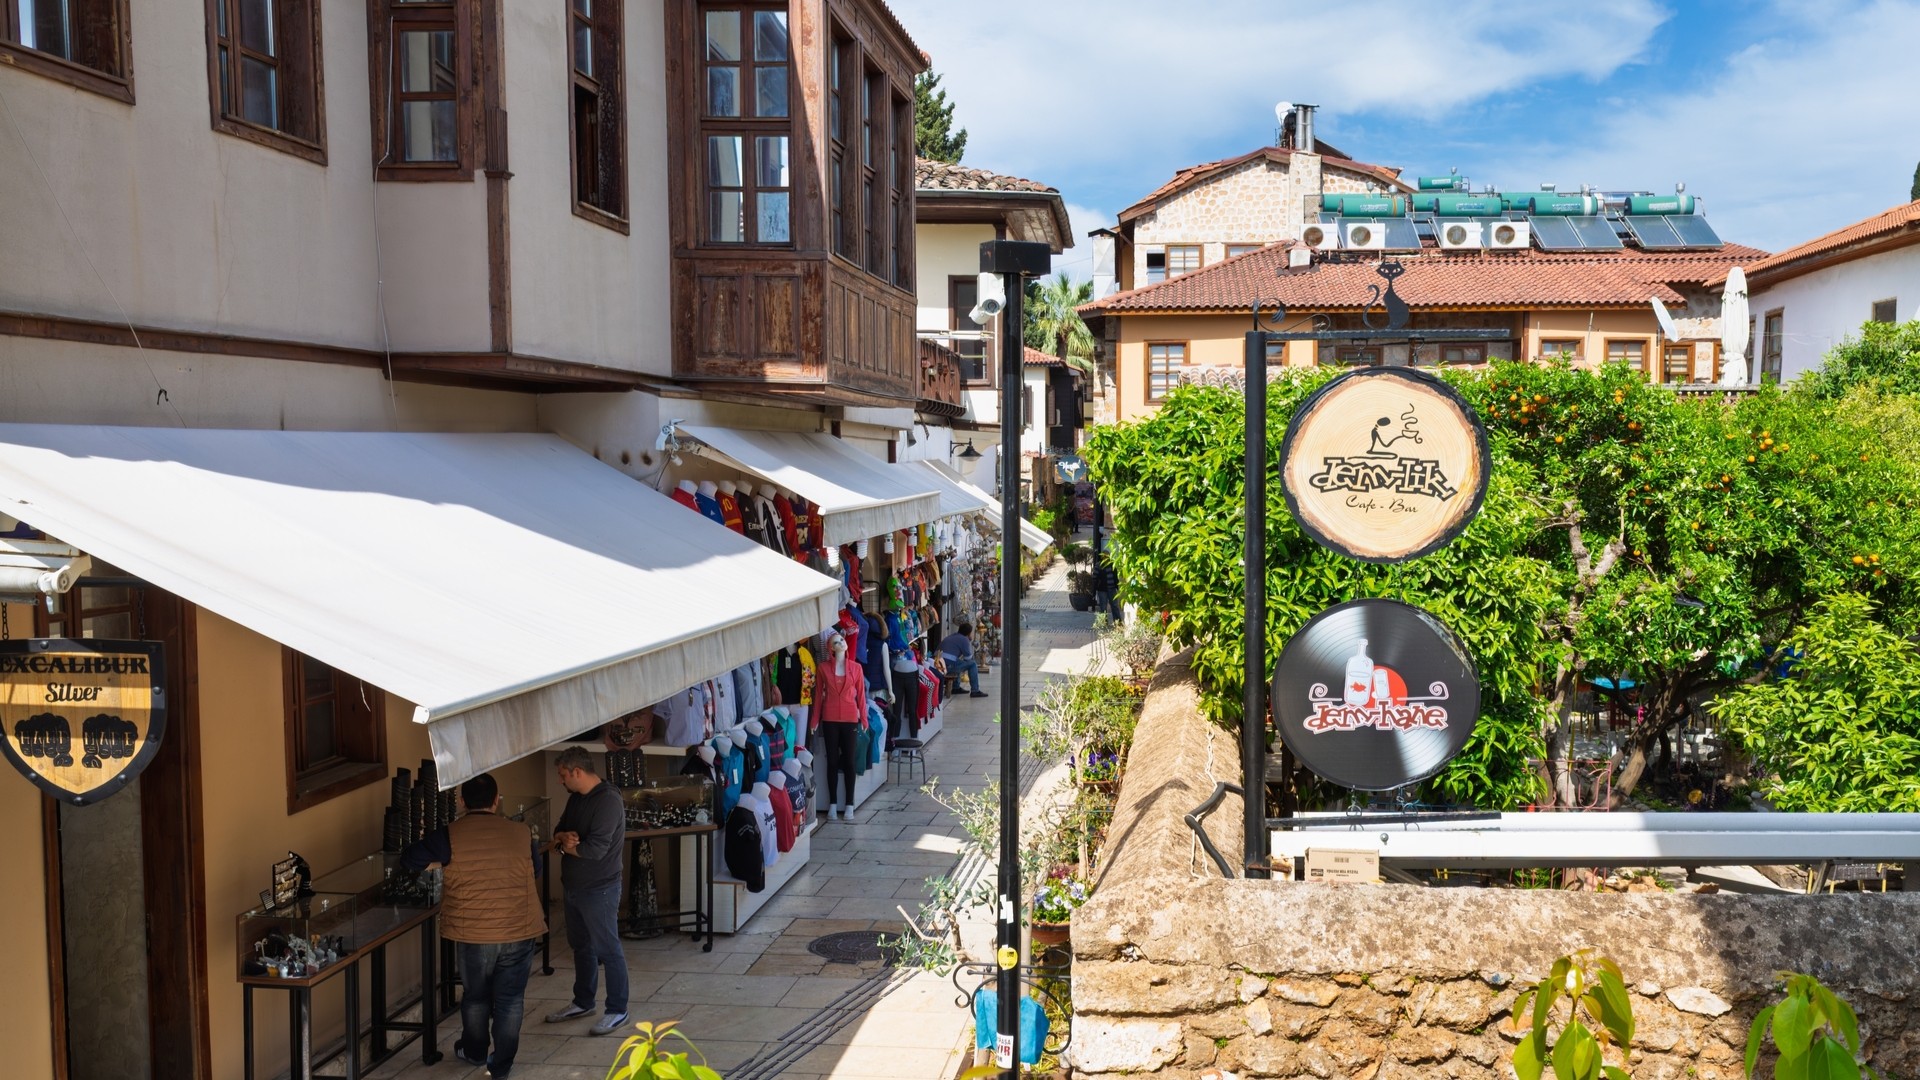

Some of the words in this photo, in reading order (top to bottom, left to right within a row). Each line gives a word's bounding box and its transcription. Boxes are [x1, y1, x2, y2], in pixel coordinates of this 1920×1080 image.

[722, 498, 733, 512] 10
[1345, 495, 1376, 513] Cafe
[1389, 498, 1418, 513] Bar
[0, 656, 149, 674] EXCALIBUR
[45, 682, 103, 703] Silver
